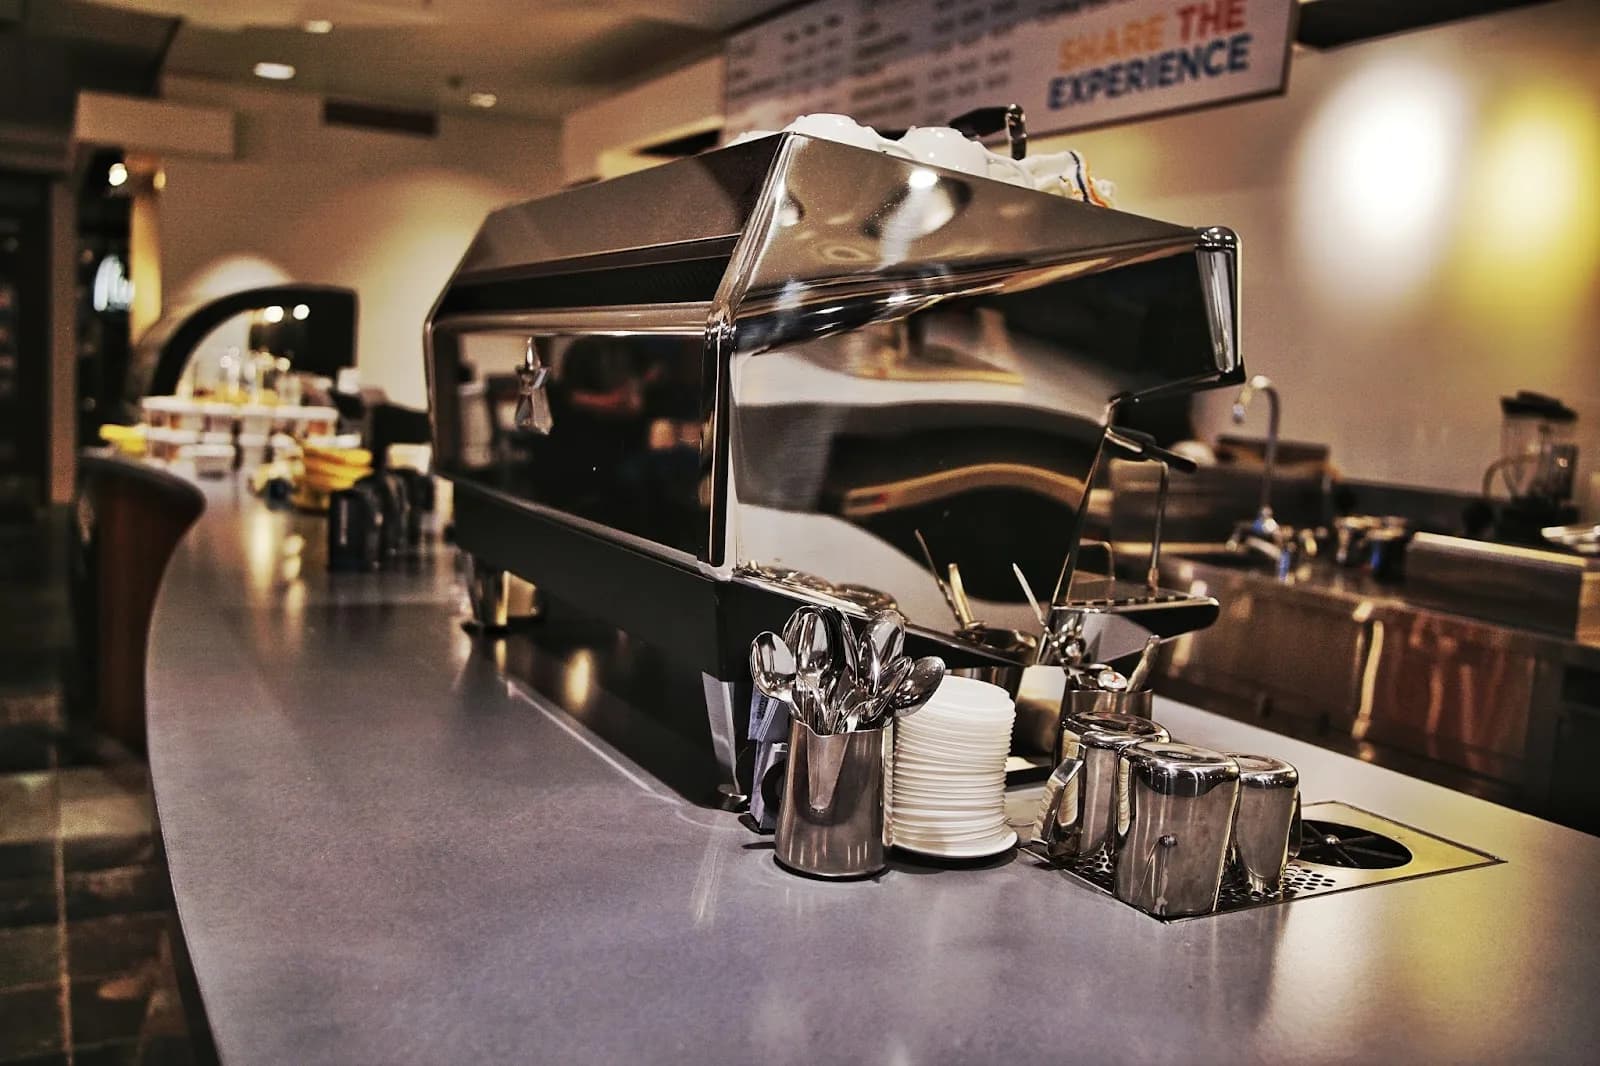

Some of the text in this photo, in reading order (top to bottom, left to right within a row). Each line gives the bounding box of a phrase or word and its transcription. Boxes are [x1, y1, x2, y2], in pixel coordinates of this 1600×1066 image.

[1047, 33, 1252, 110] EXPERIENCE
[1059, 0, 1246, 71] SHARE THE
